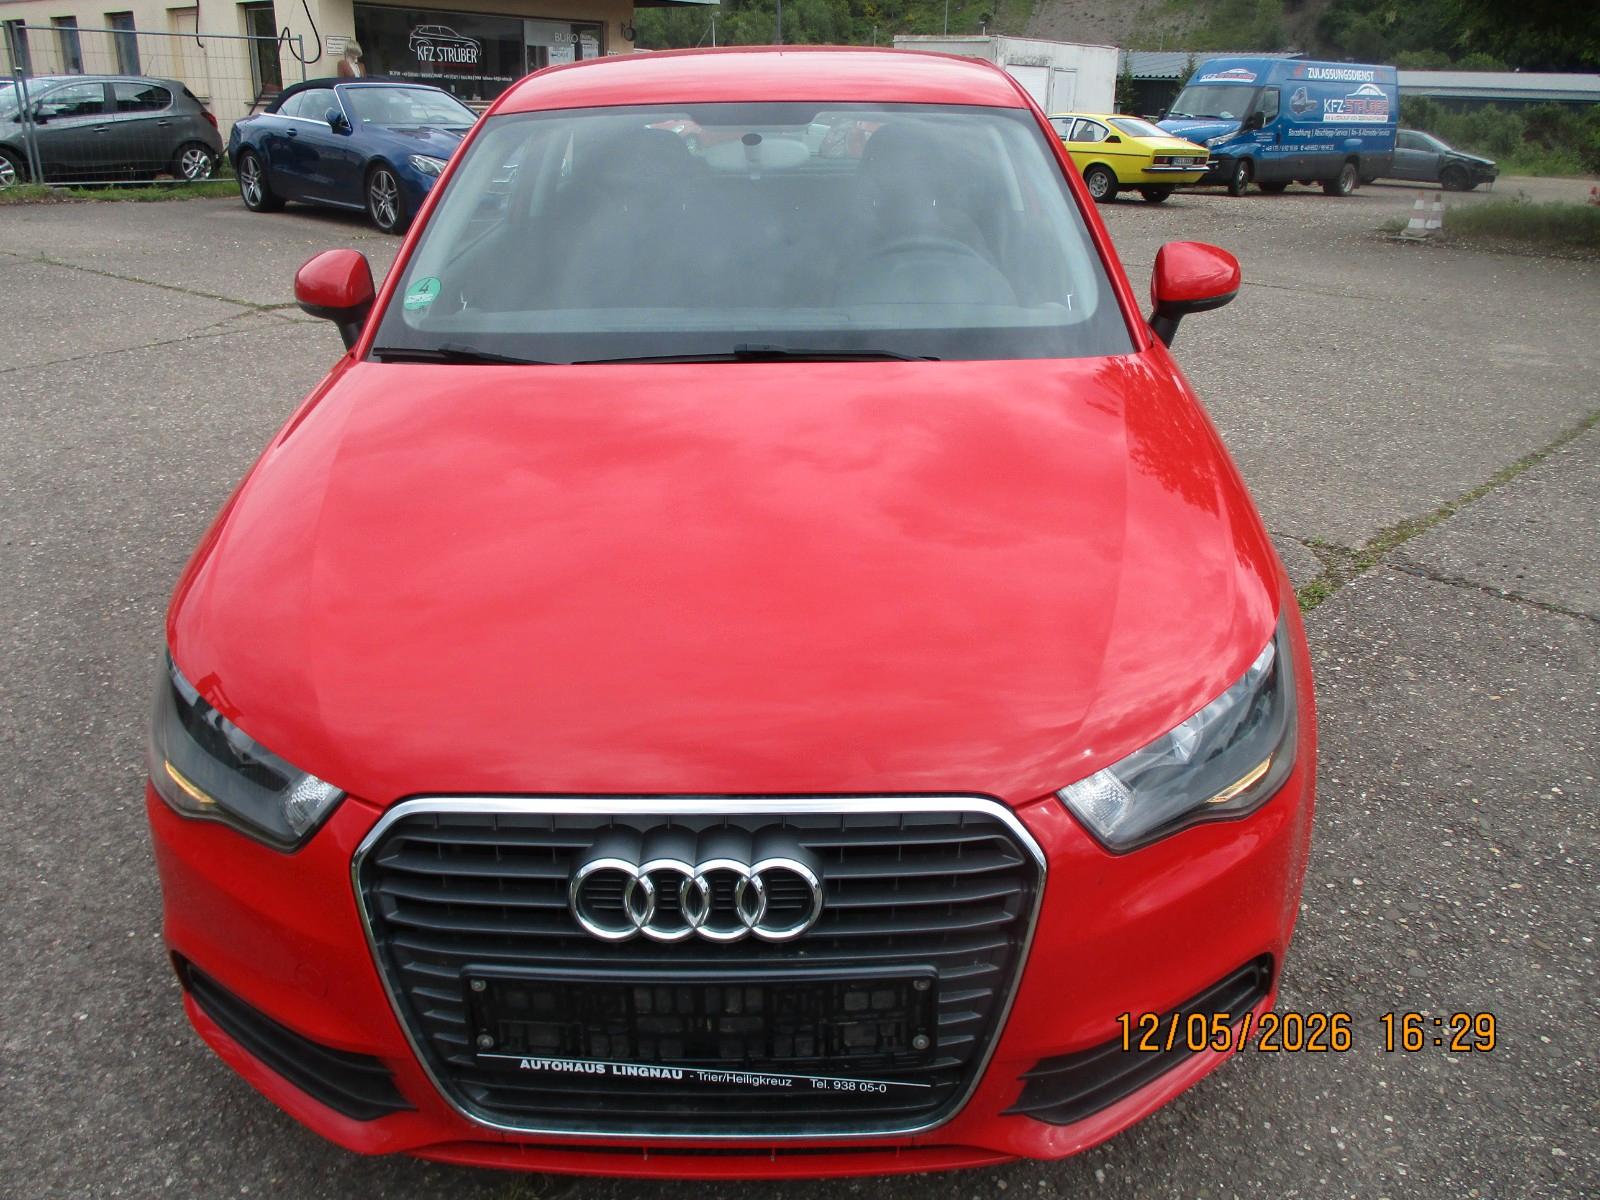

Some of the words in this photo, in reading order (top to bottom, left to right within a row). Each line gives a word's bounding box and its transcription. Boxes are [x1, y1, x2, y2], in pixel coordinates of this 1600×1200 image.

[417, 45, 435, 61] KFZ
[437, 44, 477, 63] STRÜBER
[1308, 68, 1374, 81] ZULASSUNGSDIENST
[419, 279, 432, 294] 4
[520, 1059, 606, 1074] AUTOHAUS
[612, 1065, 683, 1080] LINGNAU
[809, 1078, 831, 1090] Tel.
[833, 1080, 856, 1092] 938
[859, 1082, 887, 1093] 05-0
